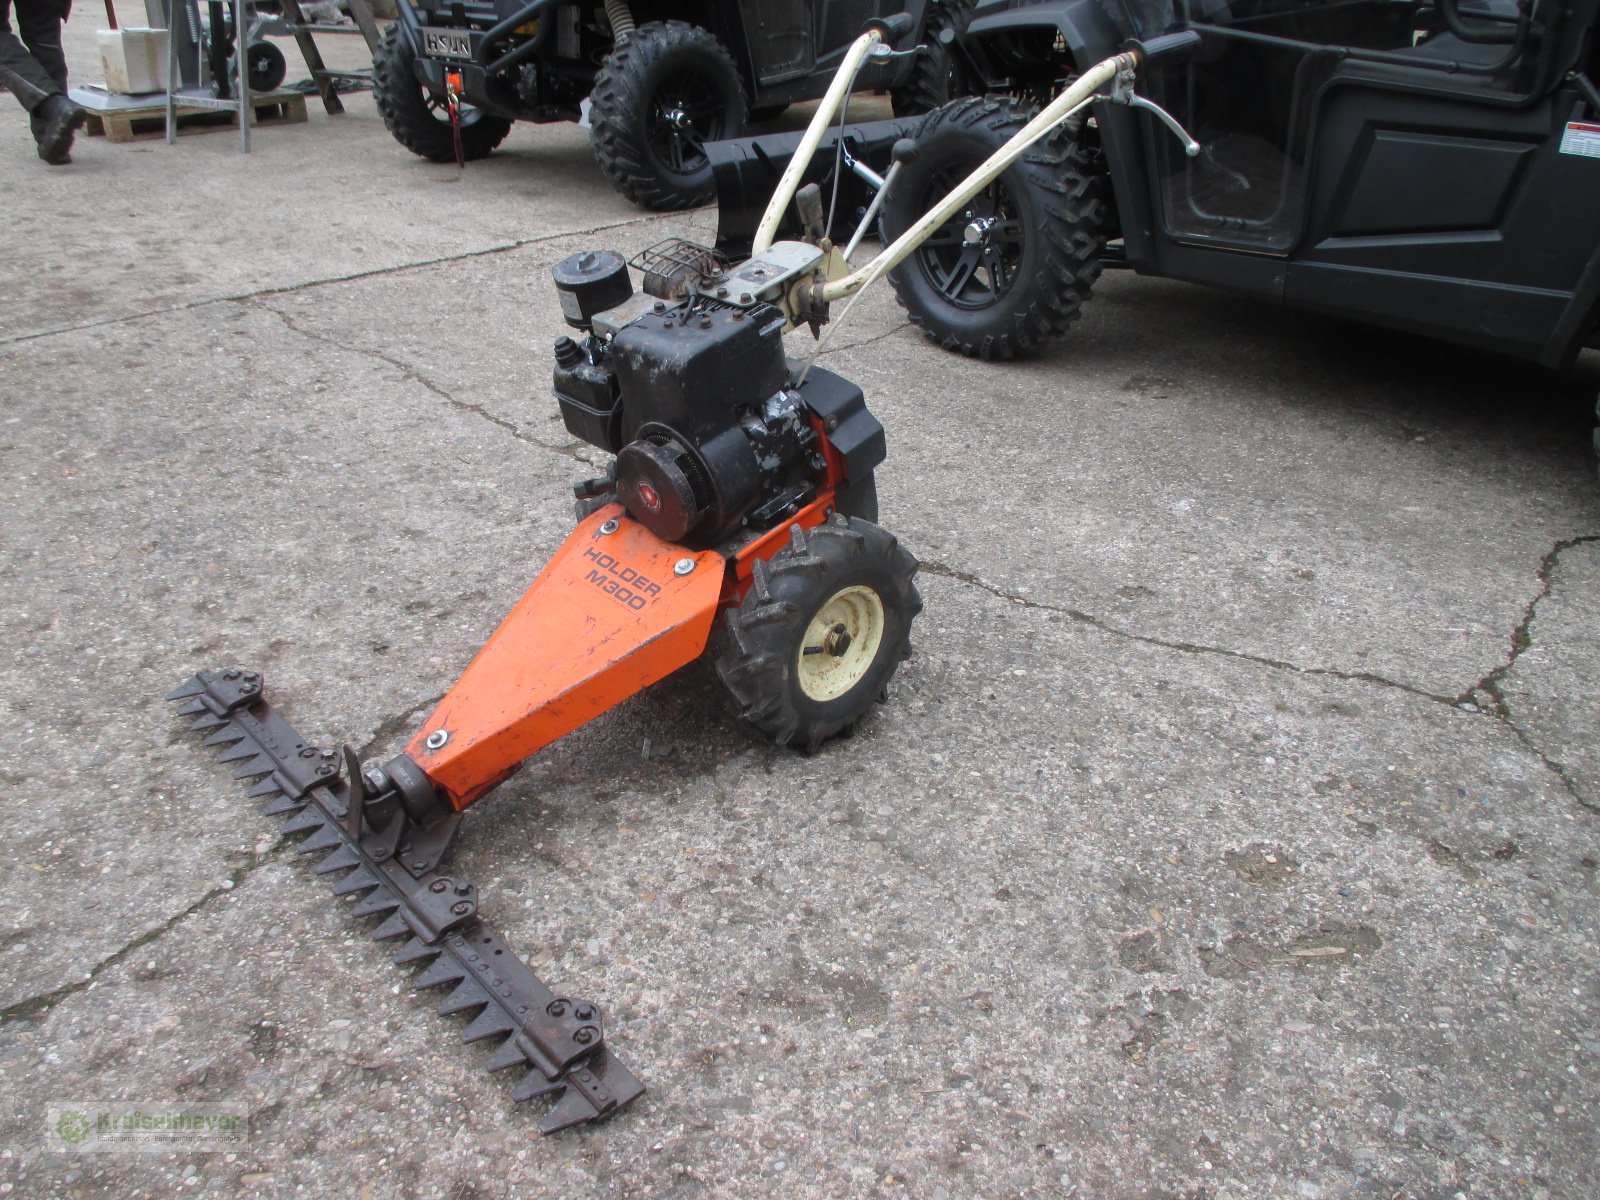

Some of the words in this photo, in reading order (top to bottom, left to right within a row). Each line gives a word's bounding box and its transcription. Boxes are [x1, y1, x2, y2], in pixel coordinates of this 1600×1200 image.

[426, 33, 469, 56] HSUN
[583, 546, 662, 597] HOLDER
[584, 569, 647, 611] M300
